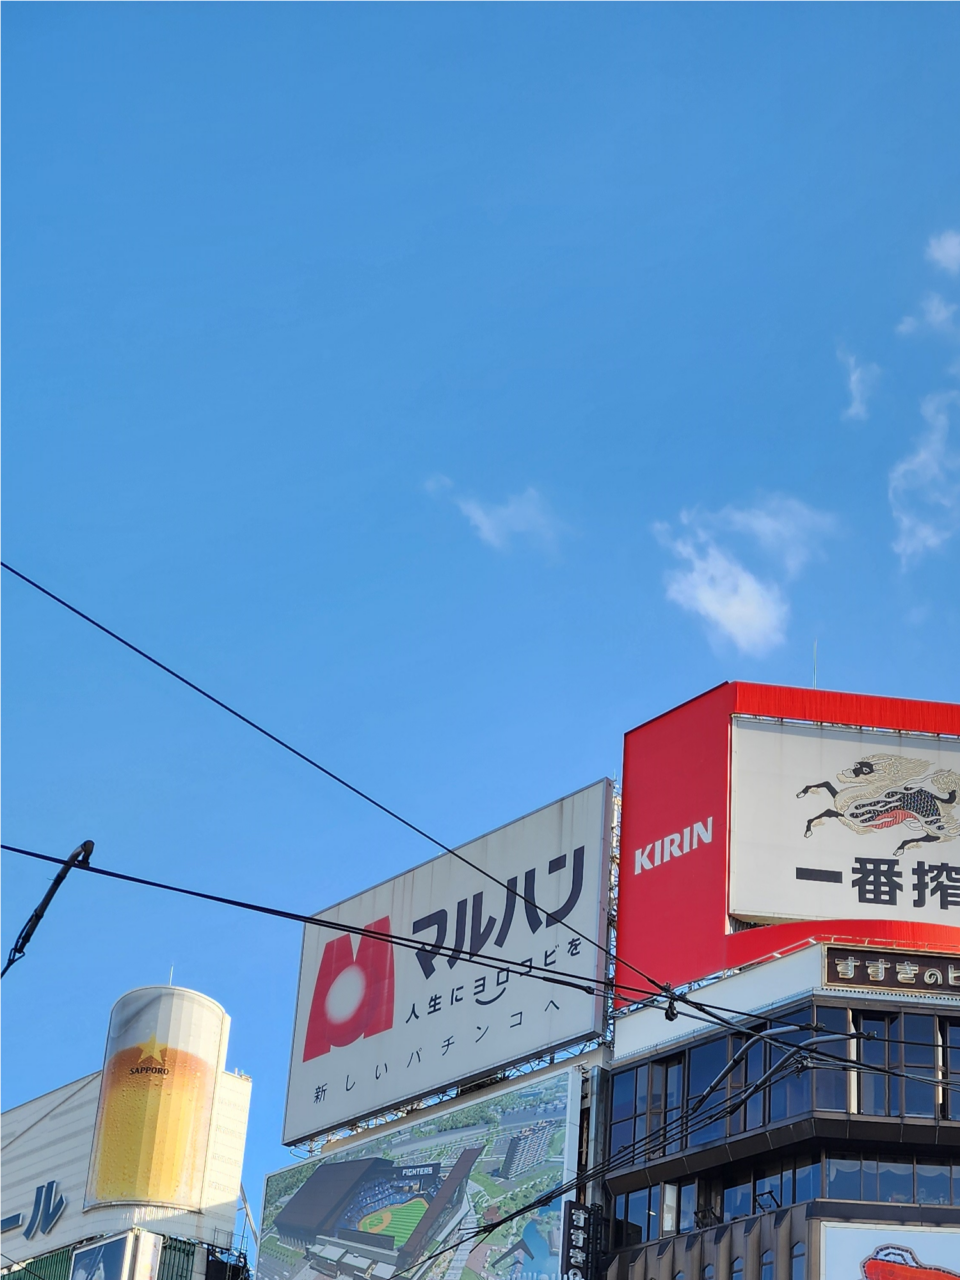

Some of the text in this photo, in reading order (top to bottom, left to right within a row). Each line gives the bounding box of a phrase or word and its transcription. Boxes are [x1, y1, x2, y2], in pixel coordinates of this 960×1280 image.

[634, 816, 714, 875] KIRIN
[412, 846, 585, 980] マルハン
[406, 937, 582, 1024] 人生にヨロコビを
[129, 1067, 169, 1076] SAPPORO
[314, 999, 560, 1103] 新しいパチンコへ
[402, 1166, 433, 1177] FIGHTERS
